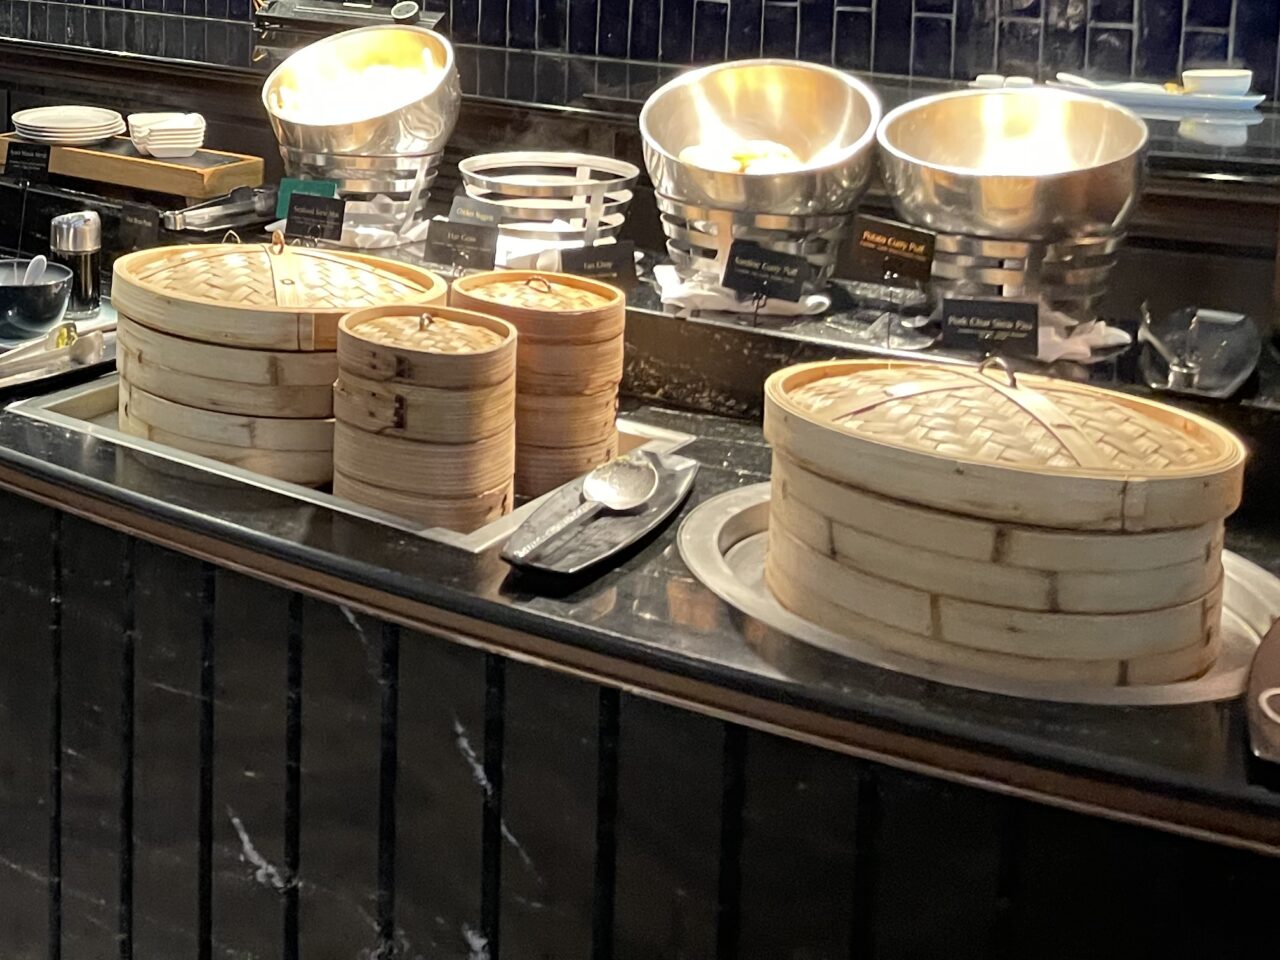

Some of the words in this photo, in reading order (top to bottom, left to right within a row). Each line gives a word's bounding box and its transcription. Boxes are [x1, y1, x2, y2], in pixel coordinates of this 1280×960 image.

[862, 230, 887, 245] Potato
[887, 236, 908, 251] Curry
[908, 242, 925, 254] Puff
[761, 262, 782, 274] Curry
[783, 265, 798, 277] Puff
